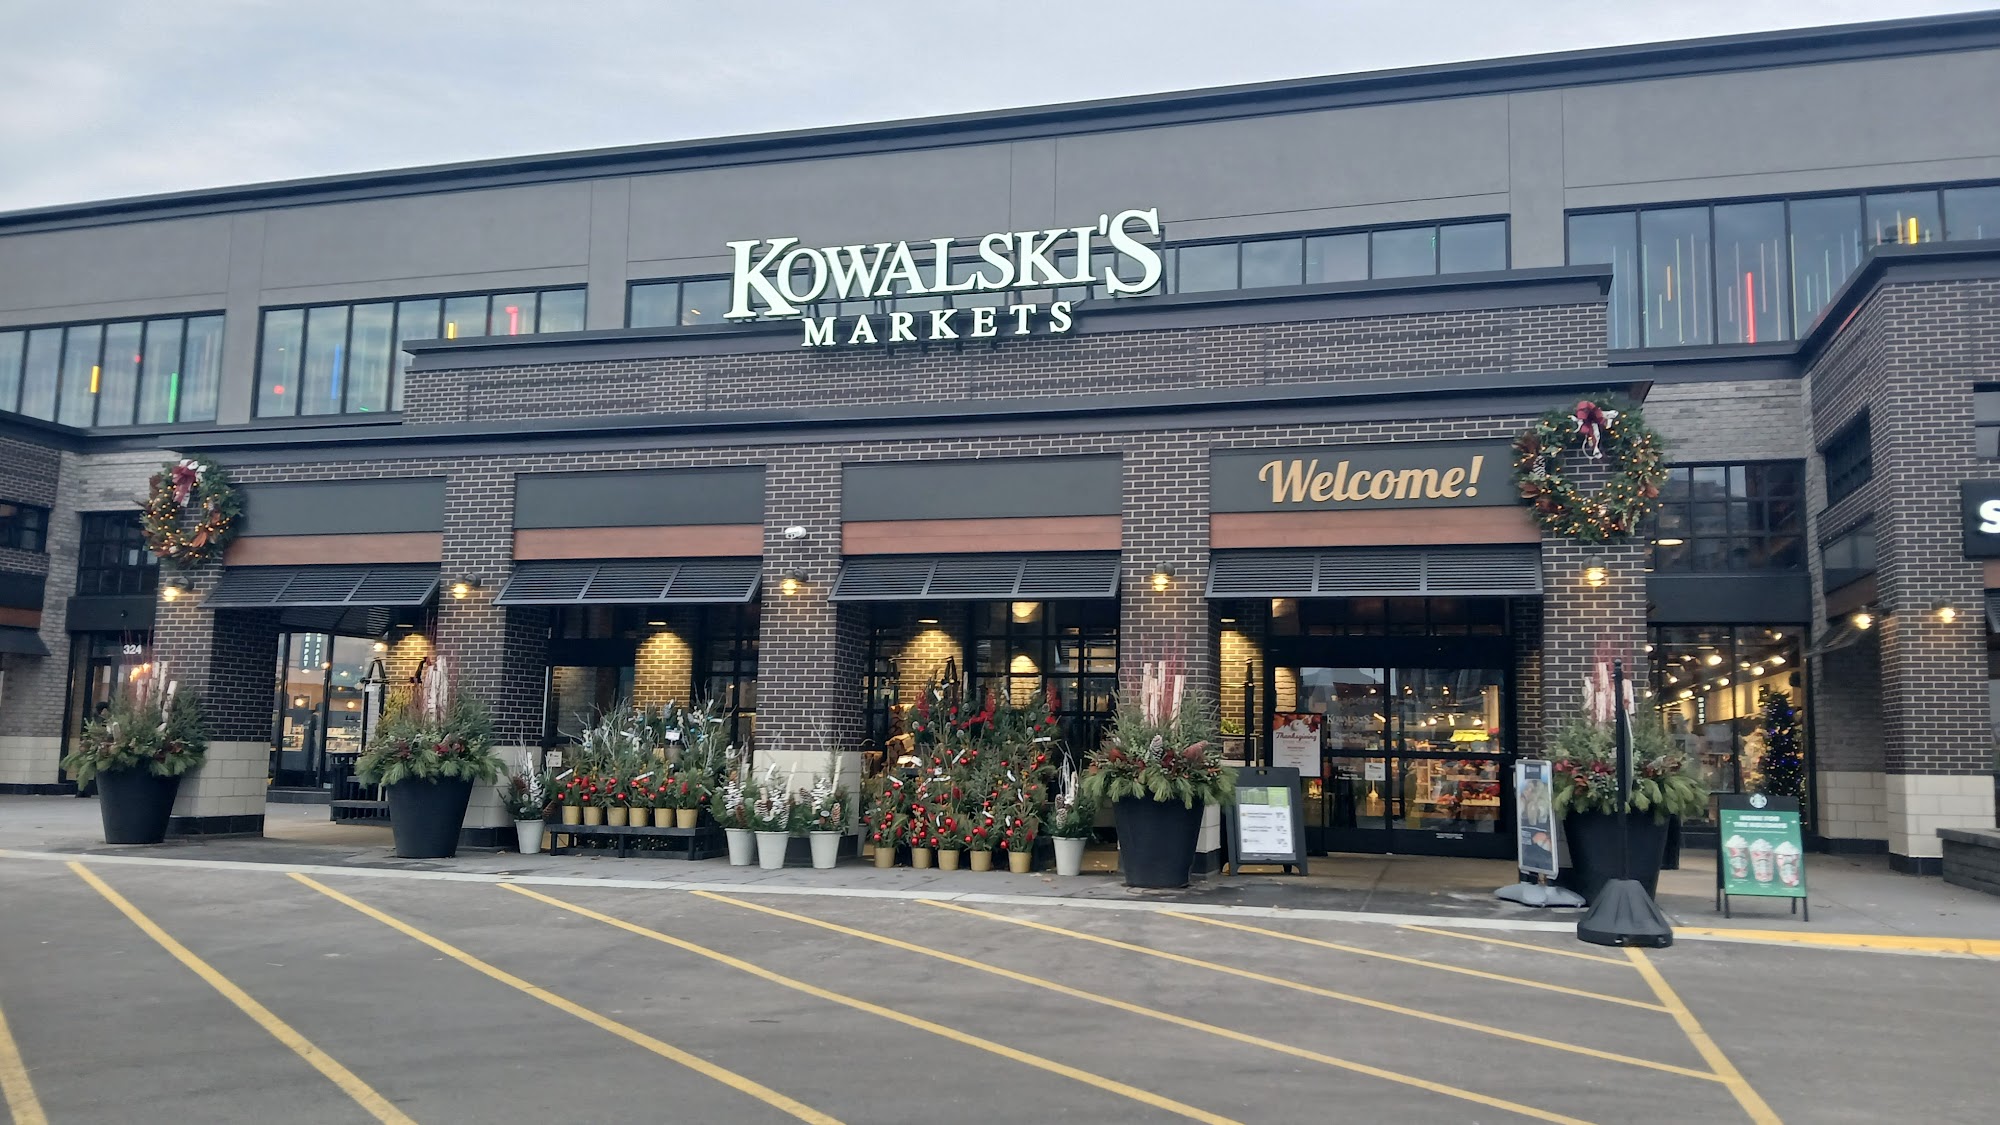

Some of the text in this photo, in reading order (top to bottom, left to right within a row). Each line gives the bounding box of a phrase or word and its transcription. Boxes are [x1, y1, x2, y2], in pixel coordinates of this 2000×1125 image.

[723, 207, 1163, 320] KOWALSKI'S
[801, 300, 1074, 348] MARKETS
[1258, 455, 1484, 503] Welcome!
[123, 644, 142, 655] 324
